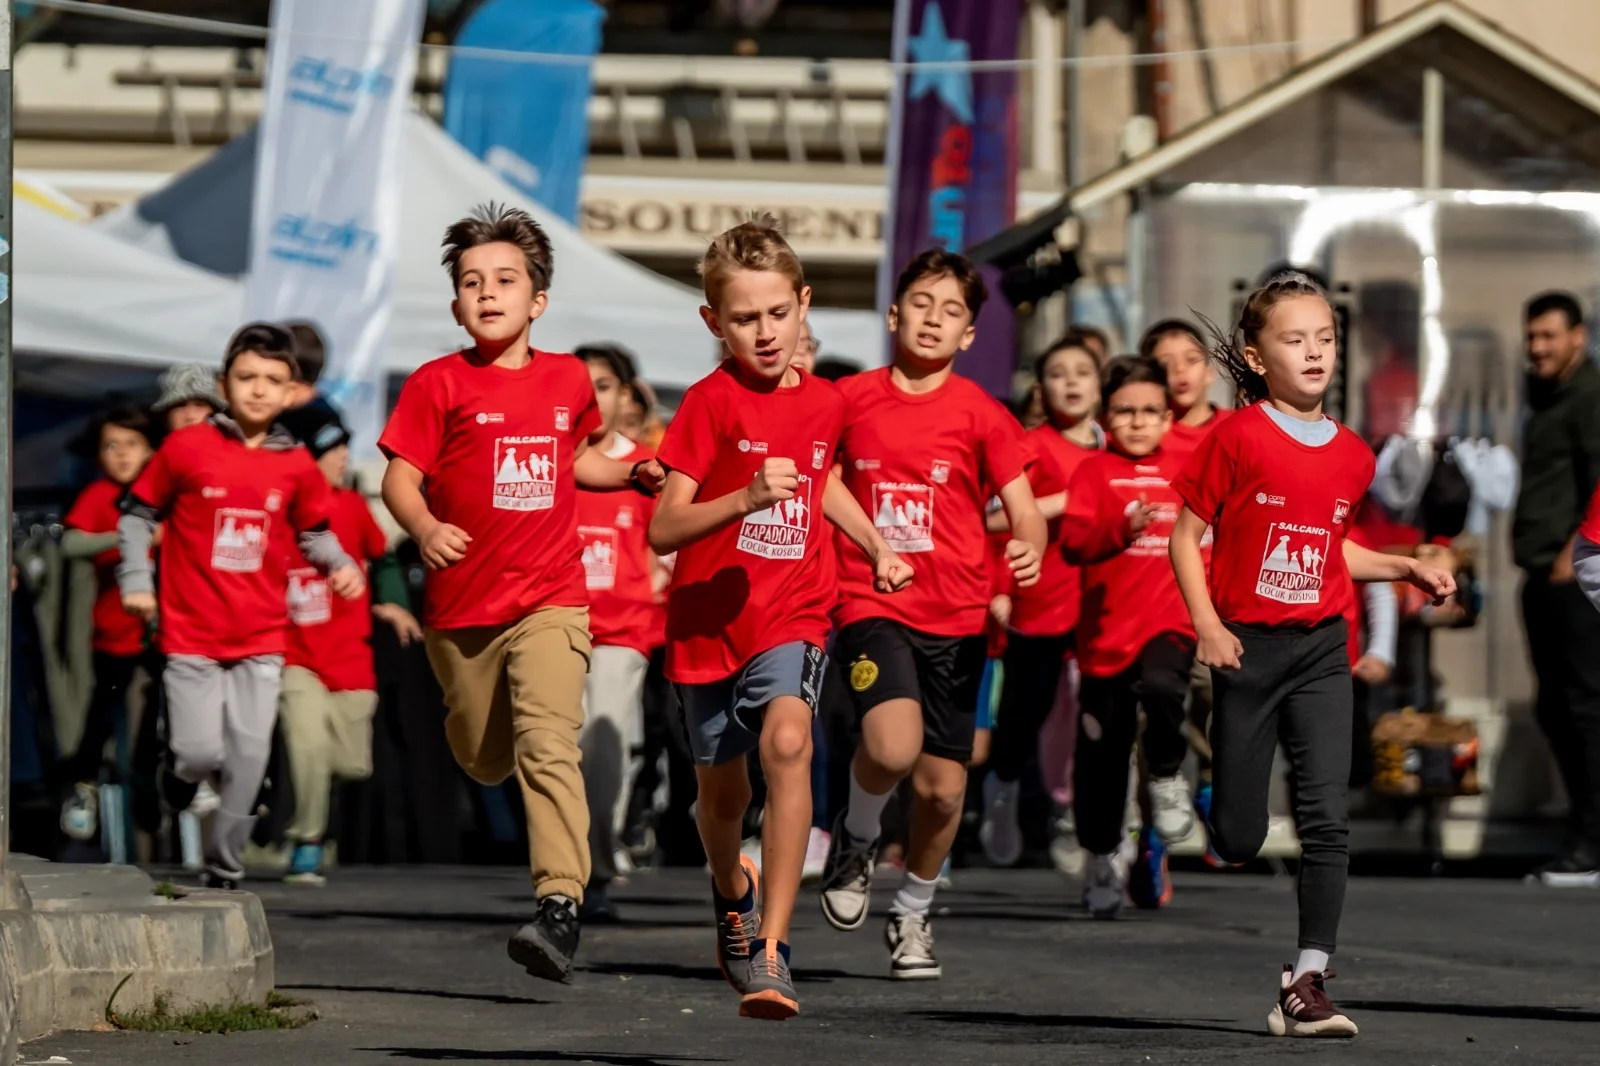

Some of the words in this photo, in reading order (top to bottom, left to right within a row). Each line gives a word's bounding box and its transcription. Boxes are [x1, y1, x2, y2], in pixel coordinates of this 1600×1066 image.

[502, 435, 552, 444] SALCANO
[496, 482, 552, 498] KAPADOKYA
[744, 524, 804, 545] KAPADOKYA
[1278, 522, 1325, 536] SALCANO
[1261, 570, 1319, 591] KAPADOKYA
